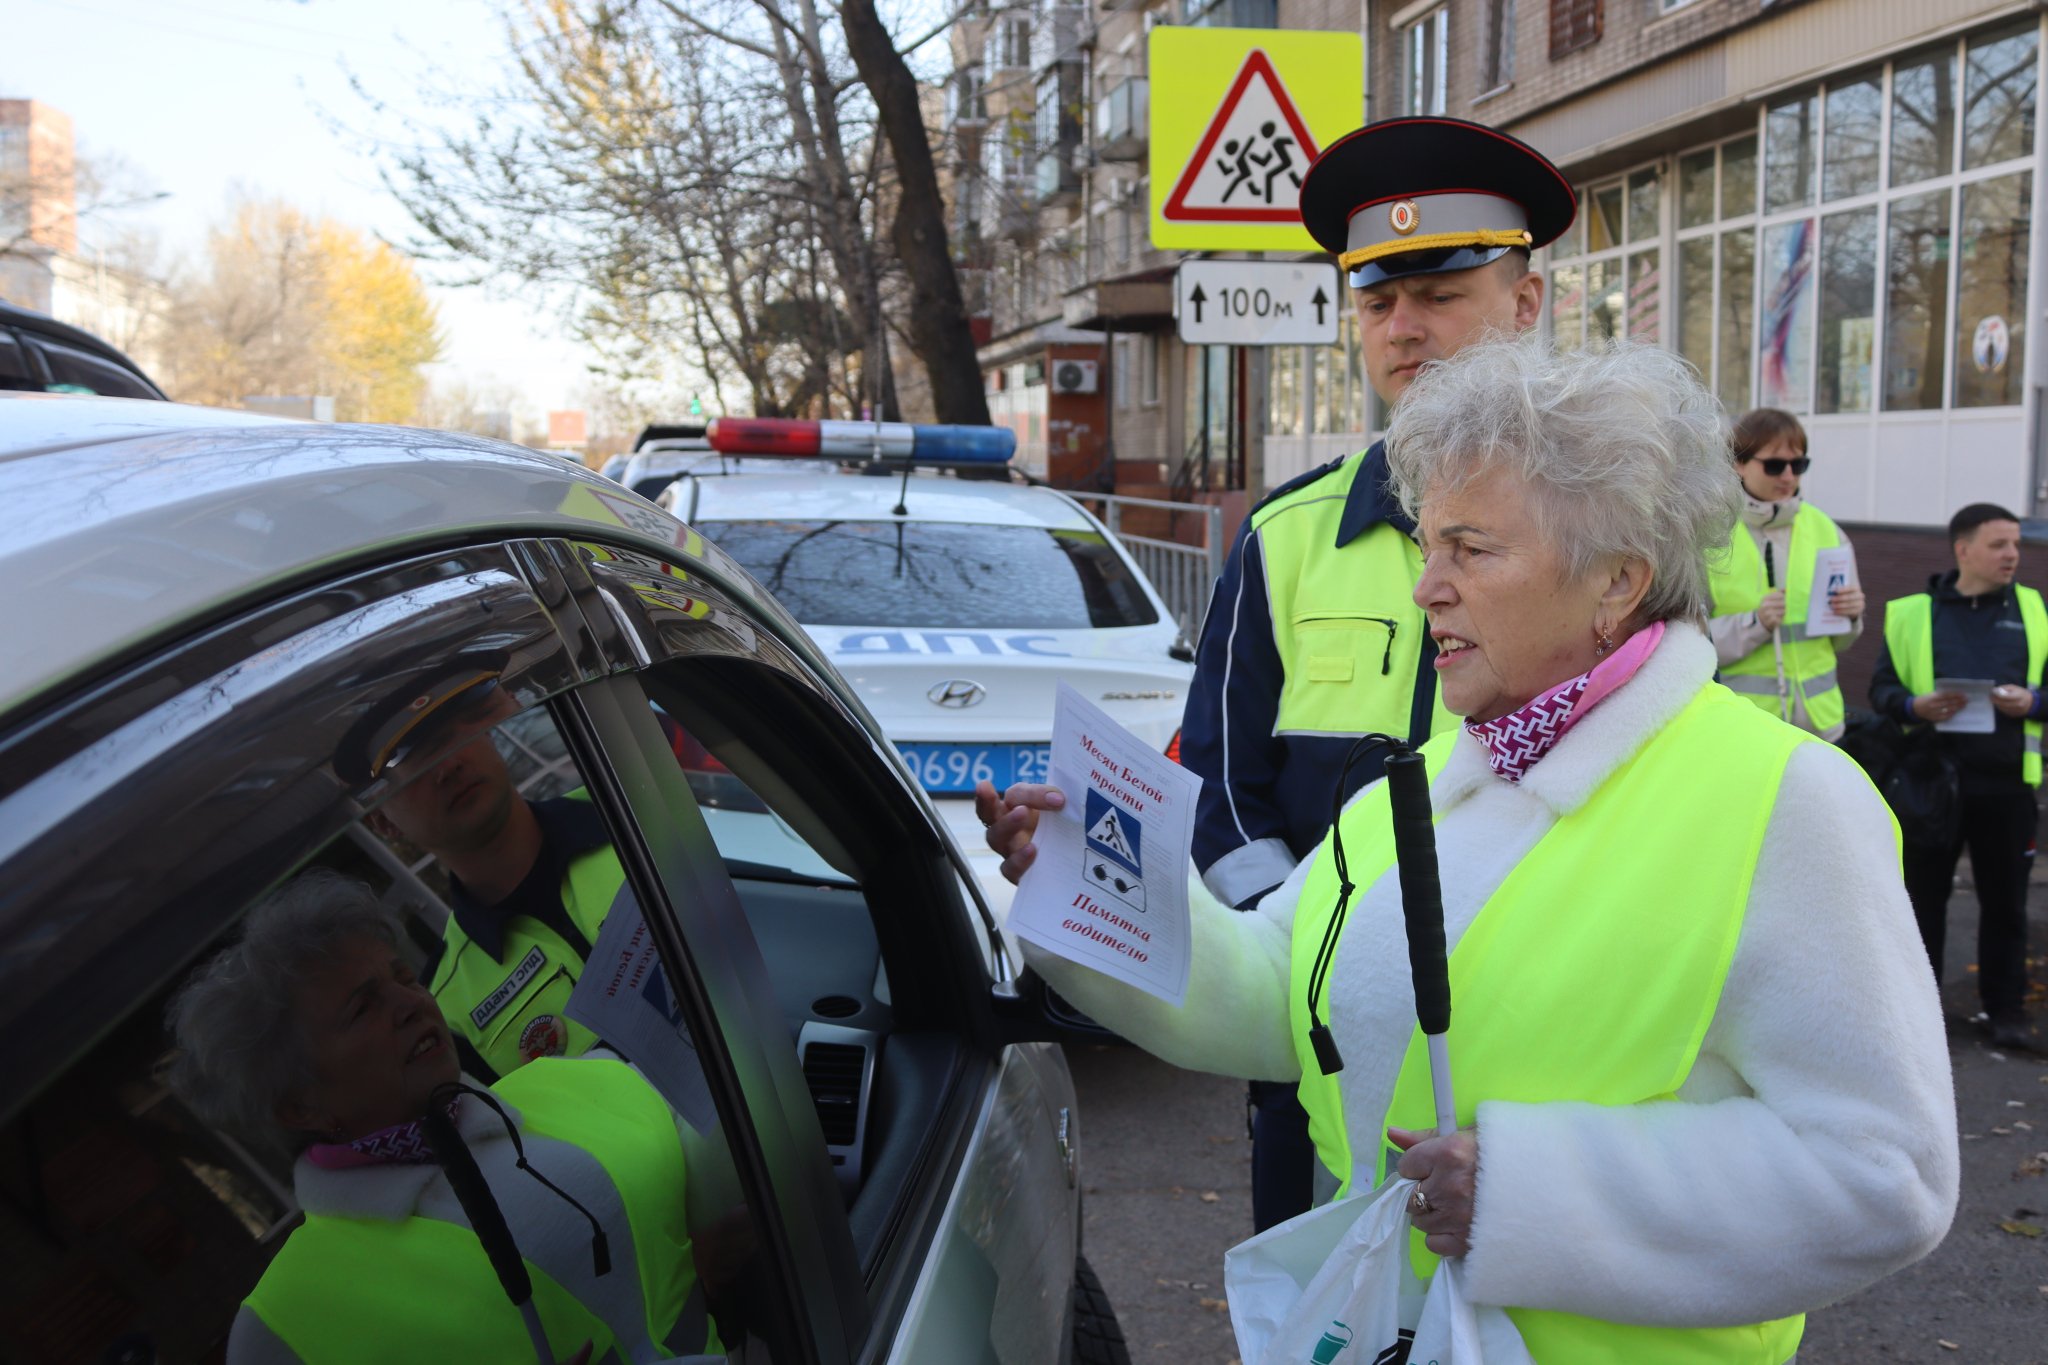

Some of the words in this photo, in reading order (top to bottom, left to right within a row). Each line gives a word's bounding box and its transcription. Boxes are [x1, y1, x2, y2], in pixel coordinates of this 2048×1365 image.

[835, 631, 1073, 658] ДПС
[1017, 750, 1050, 777] 25
[1080, 735, 1119, 777] Месяц
[1121, 767, 1163, 804] Белой
[1090, 769, 1145, 813] трости
[1062, 917, 1149, 963] водителю
[1071, 893, 1152, 944] Памятка
